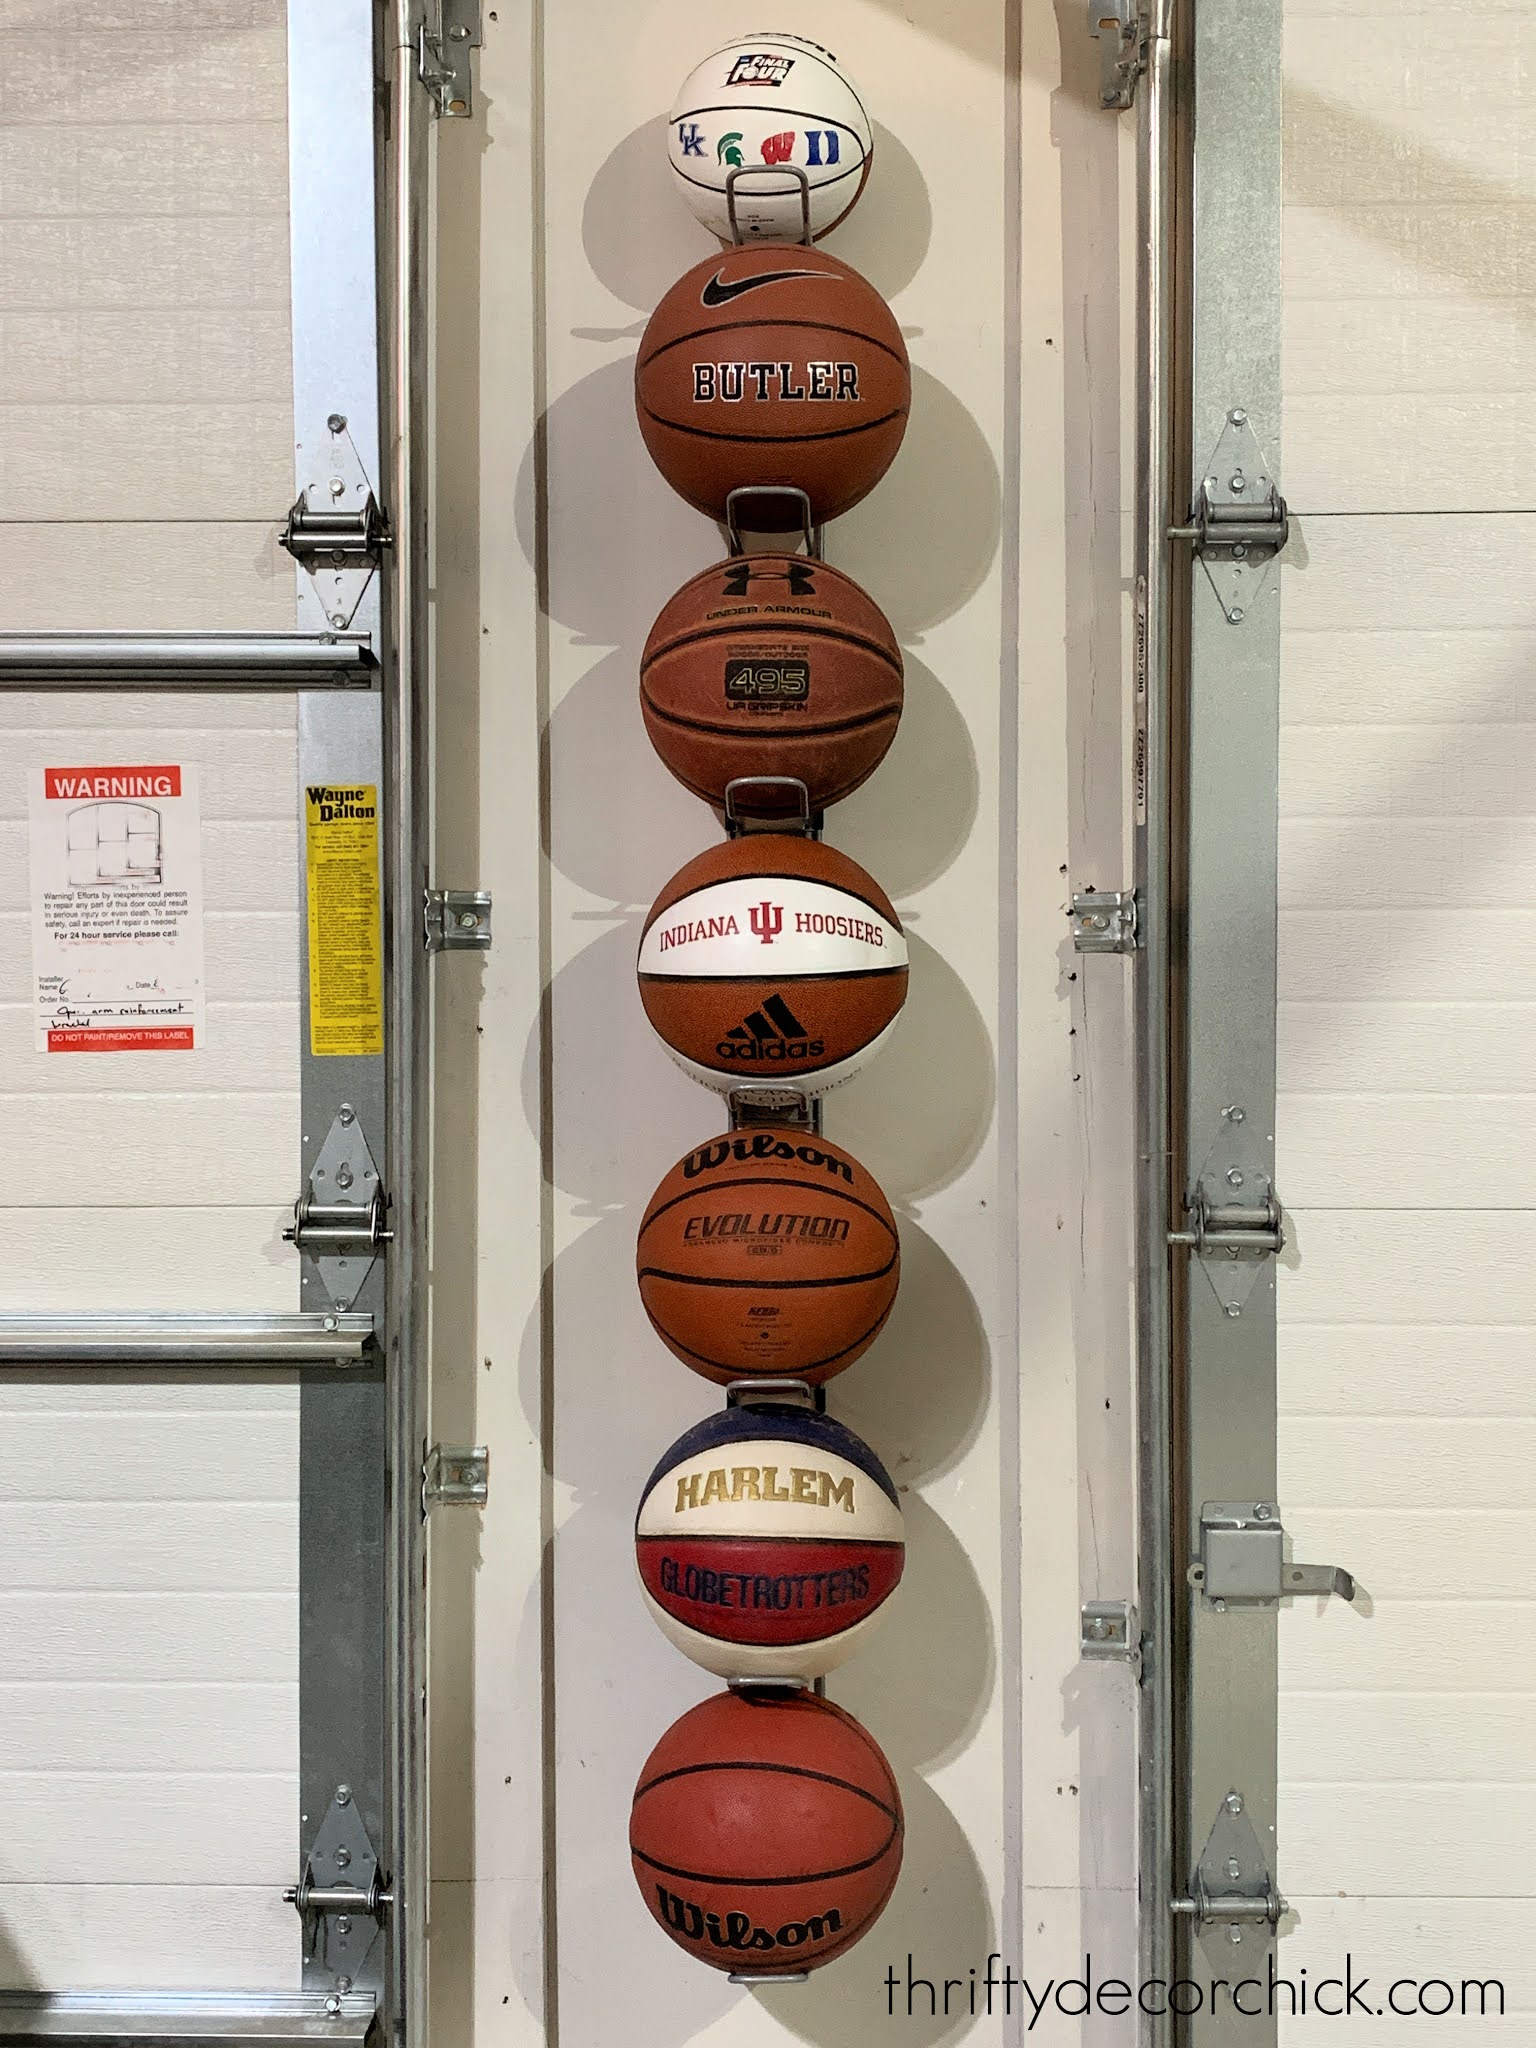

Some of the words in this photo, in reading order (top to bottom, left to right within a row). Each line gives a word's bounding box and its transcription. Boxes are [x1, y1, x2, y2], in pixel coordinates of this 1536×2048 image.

[750, 56, 790, 69] FINAL
[731, 63, 787, 82] FOUR
[692, 361, 861, 402] BUTLER
[706, 606, 758, 620] UNDER
[763, 605, 832, 620] ARMOUR
[729, 668, 806, 694] 495
[54, 776, 172, 798] WARNING
[306, 787, 365, 807] Wayne
[320, 805, 375, 822] Dalton
[77, 892, 99, 900] Efforts
[102, 892, 111, 900] by
[163, 891, 188, 899] person
[90, 901, 104, 909] part
[130, 900, 145, 908] door
[147, 899, 166, 907] could
[168, 899, 188, 907] result
[53, 911, 78, 919] serious
[80, 911, 99, 920] injury
[154, 908, 163, 916] To
[68, 920, 81, 928] call
[92, 919, 114, 928] expert
[122, 919, 141, 928] repair
[54, 932, 68, 940] For
[81, 931, 101, 939] hour
[102, 931, 132, 939] service
[134, 930, 161, 939] please
[162, 930, 180, 938] call:
[660, 915, 740, 952] INDIANA
[795, 912, 883, 947] HOOSIERS
[135, 981, 151, 989] Date
[51, 1033, 64, 1042] DO
[65, 1033, 83, 1041] NOT
[84, 1032, 143, 1041] PAINT/REMOVE
[144, 1031, 163, 1040] THIS
[164, 1031, 189, 1039] LABEL
[716, 1039, 825, 1060] adidas
[683, 1134, 854, 1185] Wilson
[683, 1213, 851, 1241] EVOLUTION
[674, 1466, 856, 1514] HARLEM
[660, 1557, 871, 1611] GLOBETROTTERS
[655, 1882, 844, 1950] Wilson
